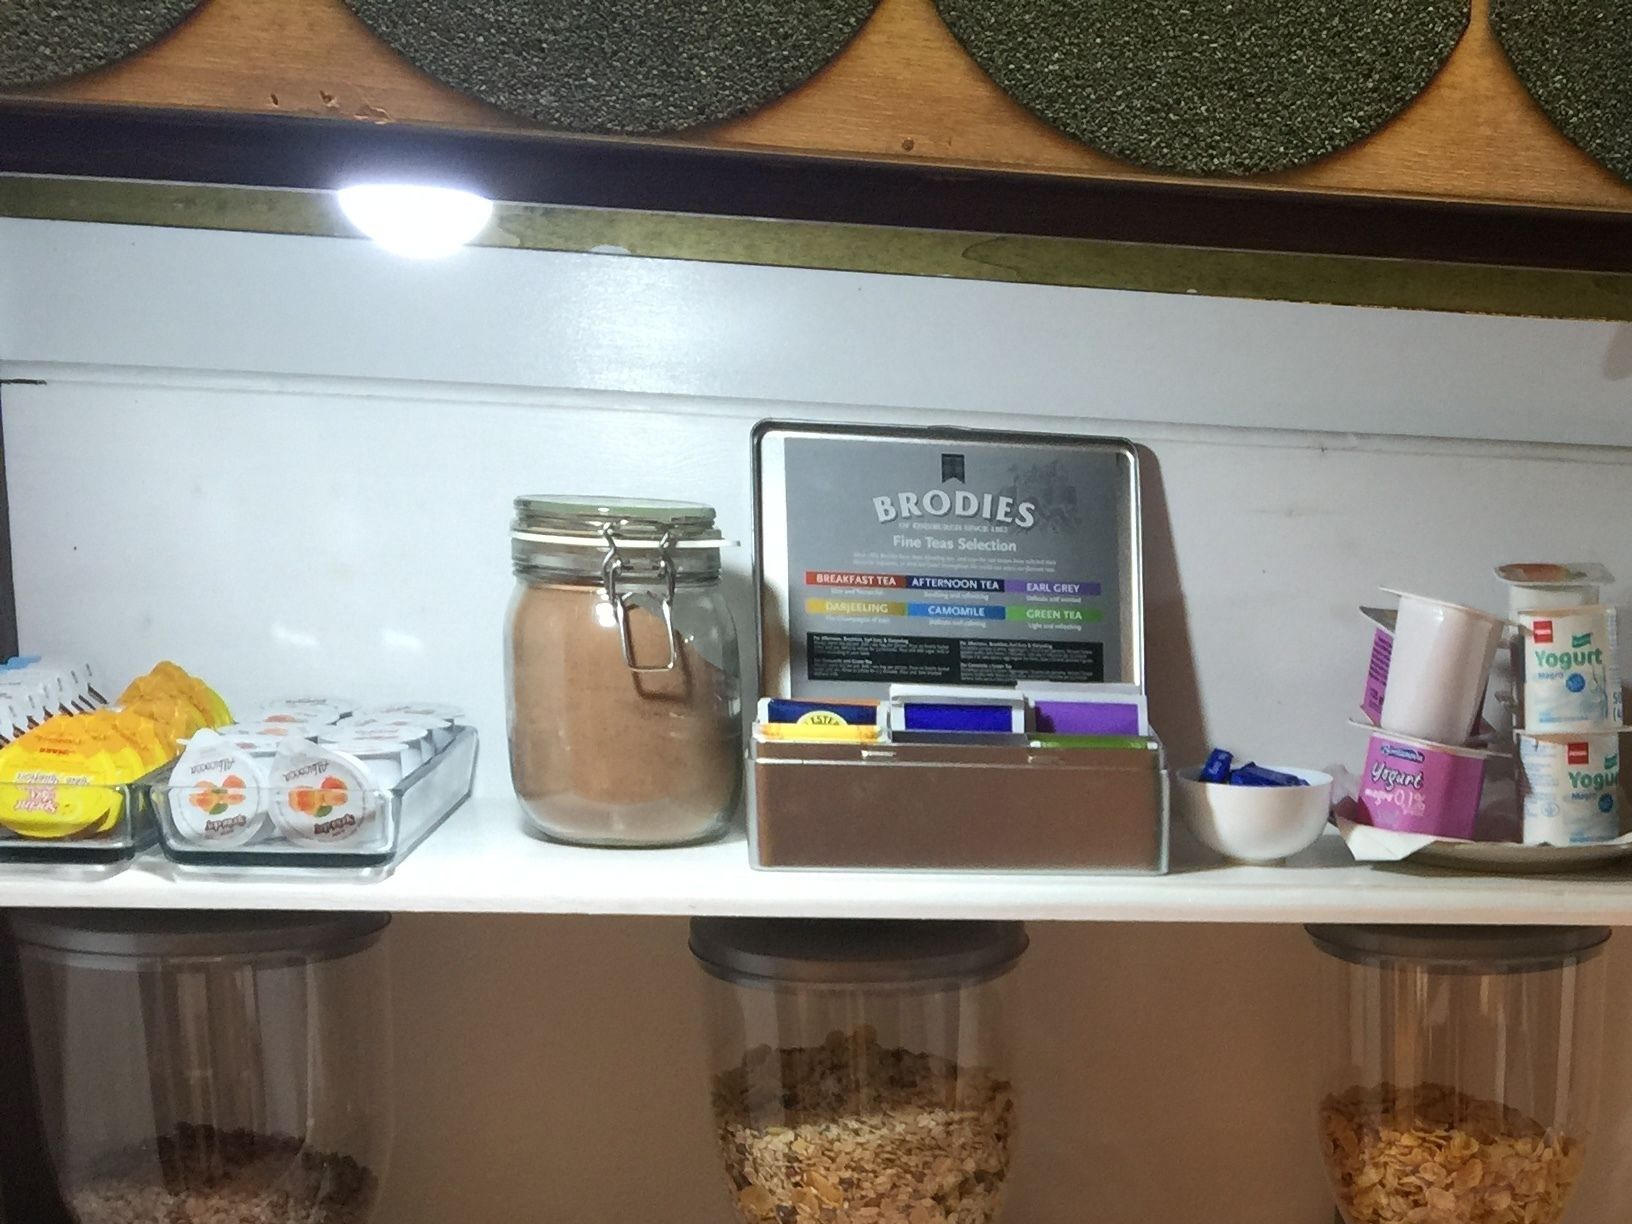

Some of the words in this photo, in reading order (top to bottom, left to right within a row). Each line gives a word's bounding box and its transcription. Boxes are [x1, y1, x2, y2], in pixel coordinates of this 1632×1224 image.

[872, 489, 1036, 528] BRODIES
[893, 535, 921, 549] Fine
[925, 536, 954, 550] Teas
[958, 537, 1017, 552] Selection
[816, 573, 874, 585] BREAKFAST
[876, 575, 896, 586] TEA
[911, 577, 977, 589] AFTERNOON
[980, 580, 999, 590] TEA
[1026, 582, 1051, 592] EARL
[1053, 583, 1080, 593] GREY
[825, 601, 889, 614] DARJEELING
[927, 605, 985, 617] CAMOMILE
[1026, 608, 1060, 619] GREEN
[1063, 610, 1082, 620] TEA
[1534, 648, 1603, 670] Yogurt
[1371, 760, 1425, 791] Yogurt
